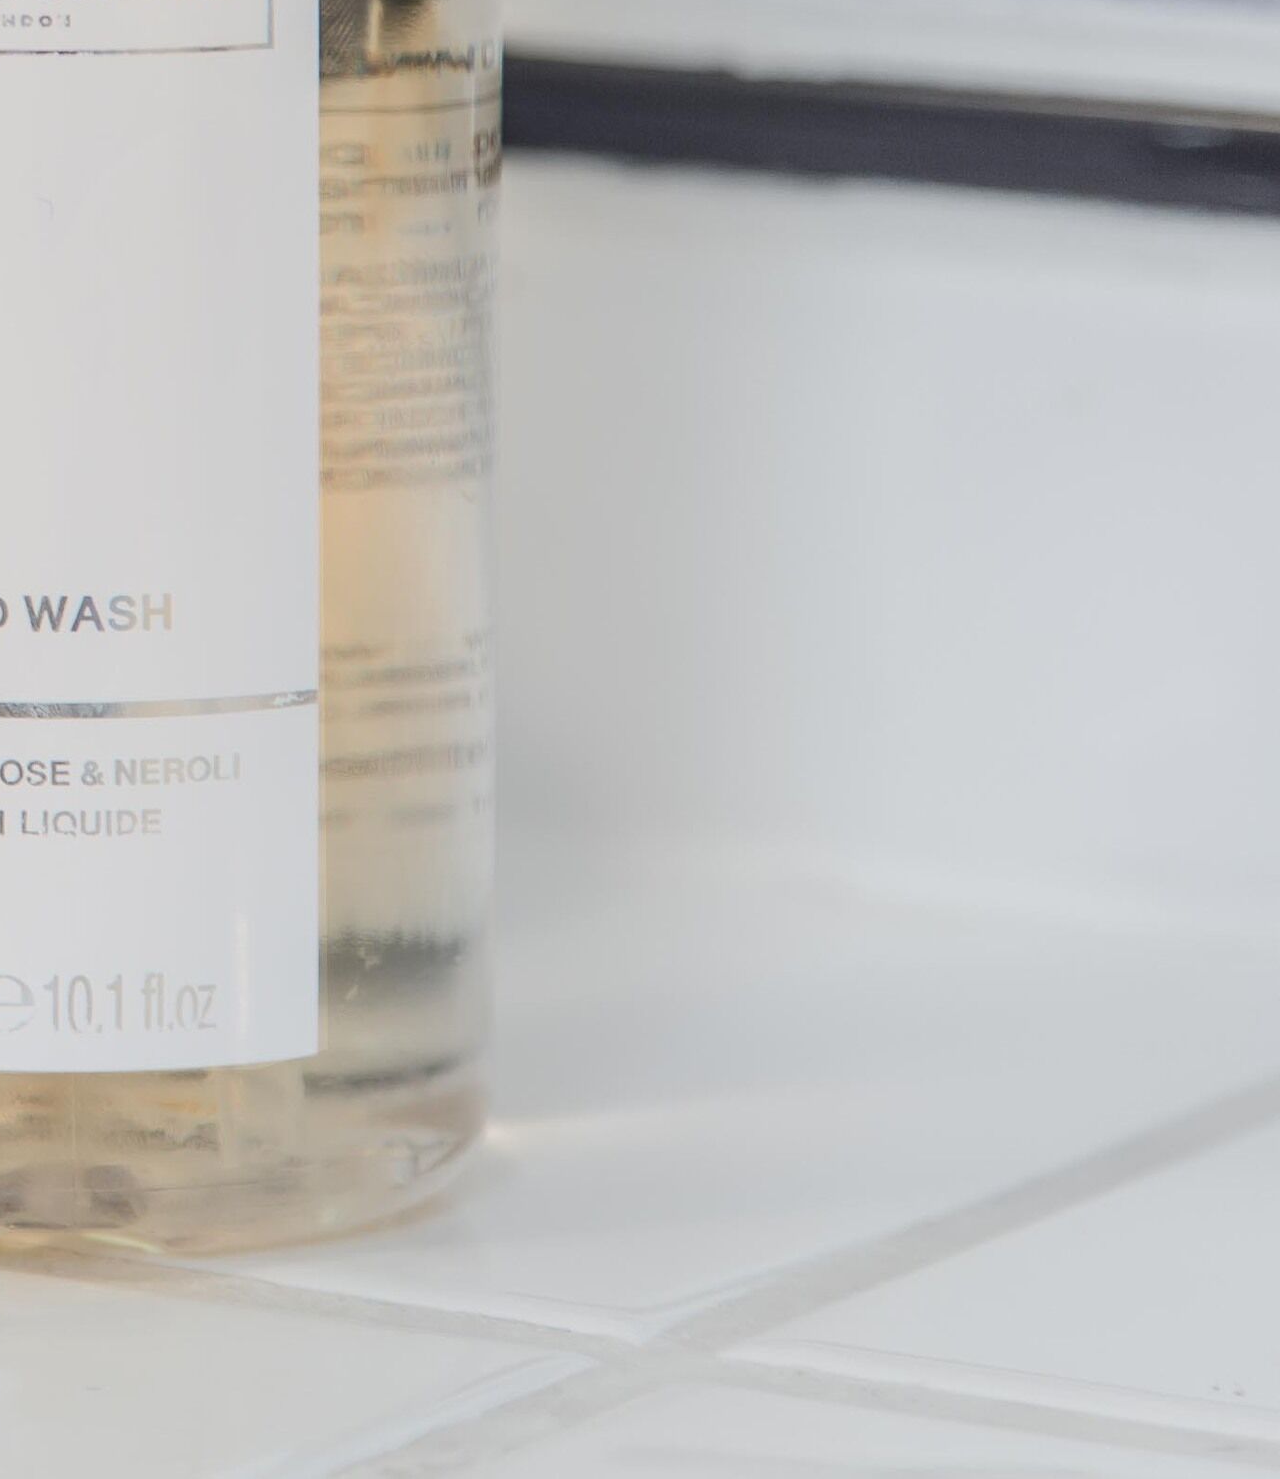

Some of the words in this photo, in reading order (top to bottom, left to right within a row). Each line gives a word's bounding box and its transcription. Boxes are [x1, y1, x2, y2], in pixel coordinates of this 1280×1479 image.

[23, 592, 173, 634] WASH
[80, 760, 106, 787] &
[114, 751, 241, 787] NEROLI
[20, 807, 163, 837] LIQUIDE
[42, 973, 124, 1035] 10.1
